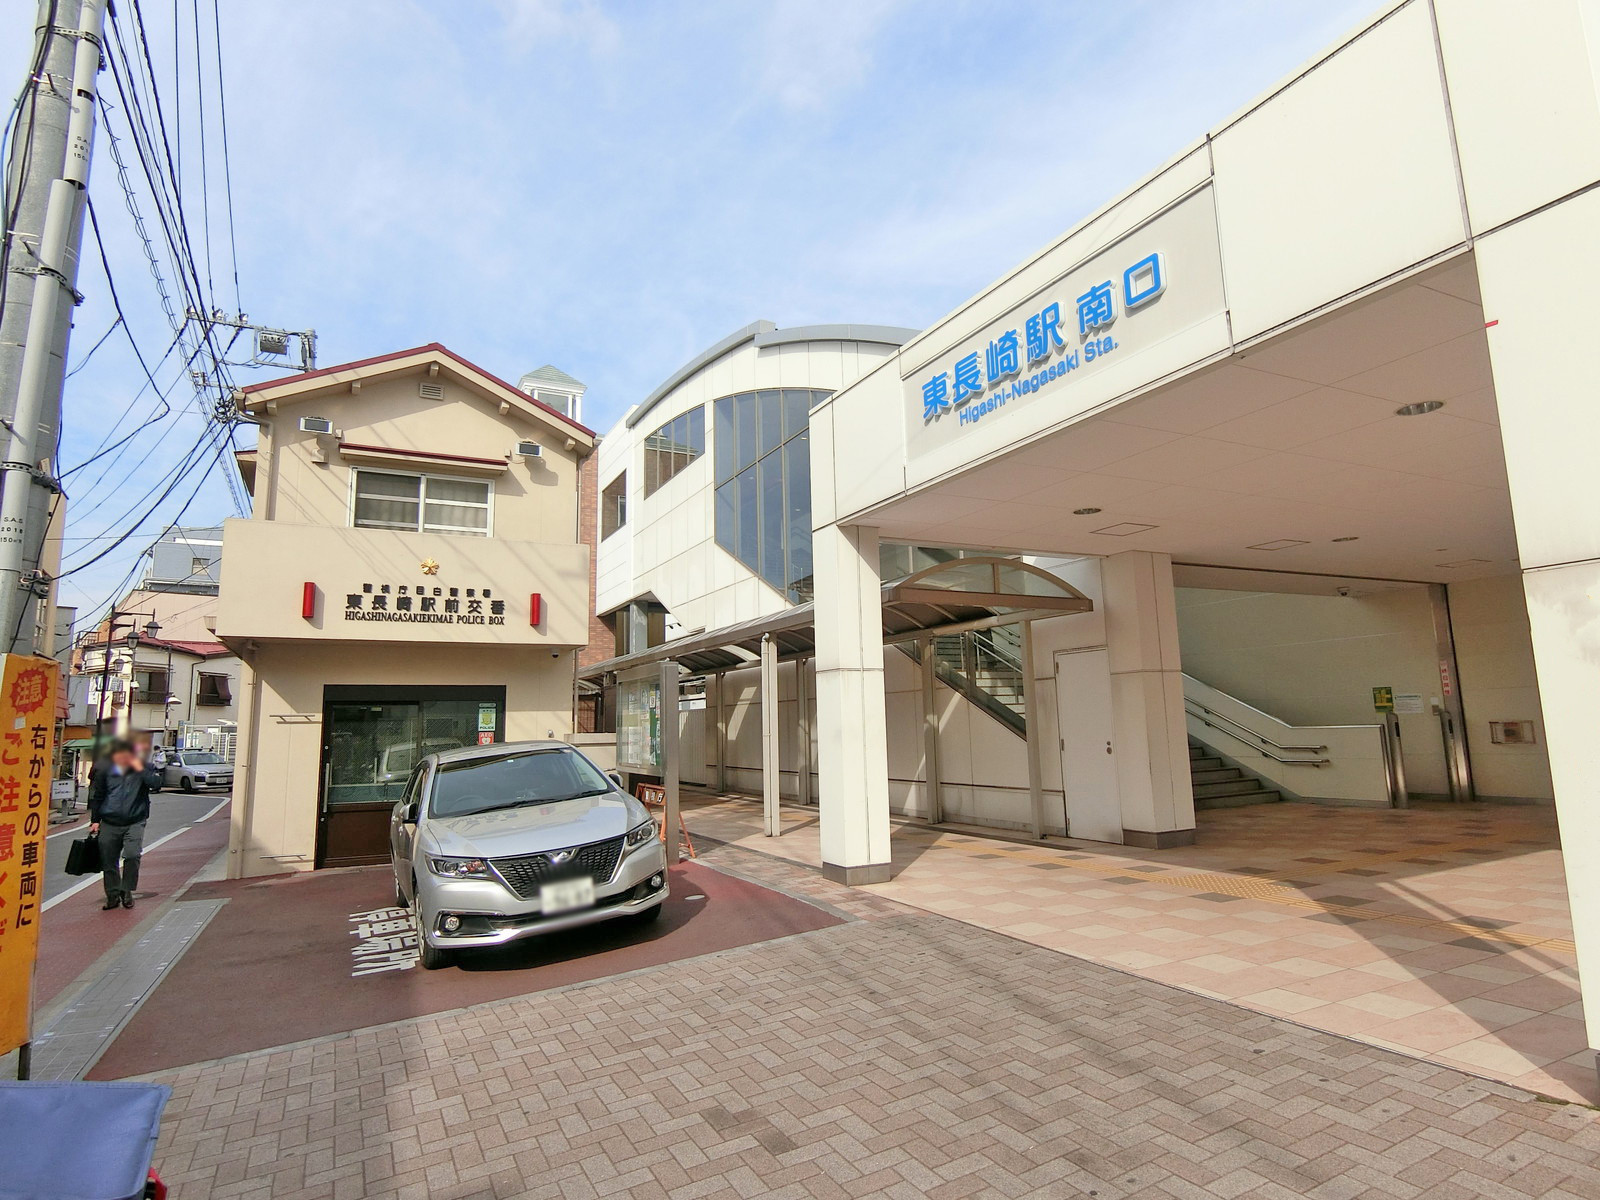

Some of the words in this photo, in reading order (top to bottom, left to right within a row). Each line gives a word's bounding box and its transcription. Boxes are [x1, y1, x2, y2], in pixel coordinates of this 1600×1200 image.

[921, 252, 1164, 420] 東長崎駅南口
[959, 351, 1080, 426] Higashi-Nagasaki
[1084, 334, 1120, 362] Sta.
[345, 594, 505, 614] 東長崎駅前交番
[345, 611, 454, 623] HIGASHINAGASAKIEKIMAE
[456, 614, 485, 625] POLICE
[488, 616, 506, 626] BOX
[15, 674, 43, 706] 注意
[15, 723, 48, 930] 右からの車両に
